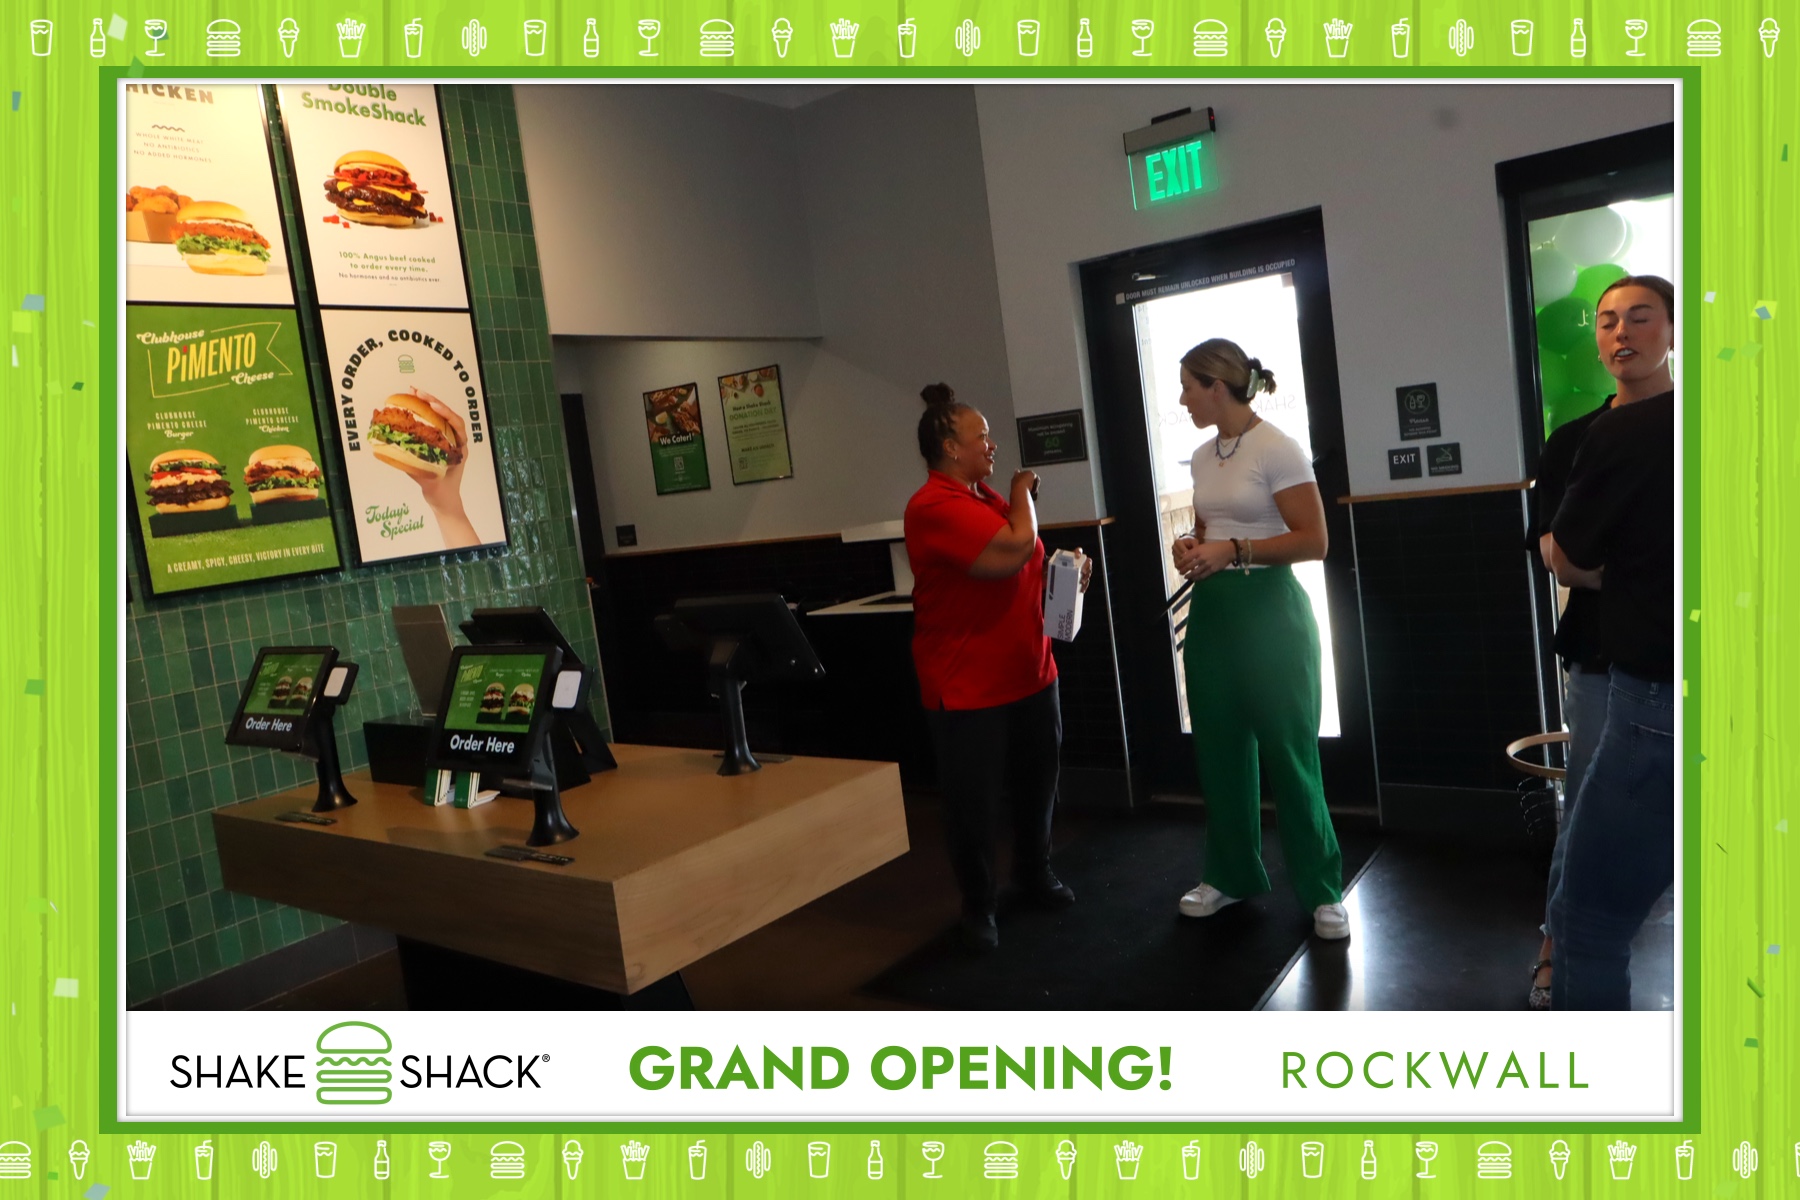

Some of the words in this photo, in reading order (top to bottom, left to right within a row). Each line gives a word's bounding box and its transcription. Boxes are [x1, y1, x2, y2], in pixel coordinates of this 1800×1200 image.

[301, 91, 427, 126] SmokeShack
[136, 132, 160, 140] WHOLE
[158, 143, 200, 153] ANTIBIOTICS
[173, 154, 212, 163] HORMONES
[1145, 140, 1203, 202] EXIT
[363, 253, 387, 262] Angus
[389, 253, 406, 262] beef
[409, 256, 436, 264] cooked
[385, 265, 407, 273] every
[400, 275, 428, 283] antibiotics
[1125, 291, 1141, 301] DOOR
[1141, 287, 1158, 297] MUST
[1158, 282, 1181, 294] REMAIN
[1181, 277, 1210, 290] UNLOCKED
[1211, 273, 1229, 284] WHEN
[1229, 266, 1257, 280] BUILDING
[1257, 264, 1265, 273] IS
[1265, 258, 1296, 272] OCCUPIED
[136, 329, 205, 345] Clubhouse
[387, 329, 454, 361] COOKED
[341, 337, 384, 390] ORDER,
[231, 371, 274, 385] Cheese
[453, 360, 470, 383] TO
[341, 393, 361, 452] EVERY
[465, 386, 484, 444] ORDER
[729, 409, 764, 421] DONATION
[164, 429, 194, 440] Burger
[258, 424, 290, 434] Chicken
[659, 436, 671, 446] We
[1393, 453, 1416, 465] EXIT
[380, 515, 425, 541] Special
[167, 563, 173, 574] A
[173, 559, 205, 572] CREAMY,
[205, 557, 228, 568] SPICY,
[228, 552, 256, 565] CHEESY,
[255, 549, 282, 561] VICTORY
[283, 549, 291, 558] IN
[291, 545, 311, 556] EVERY
[311, 543, 325, 554] BITE
[245, 717, 271, 731] Order
[270, 717, 293, 732] Here
[449, 734, 485, 752] Order
[485, 736, 515, 755] Here
